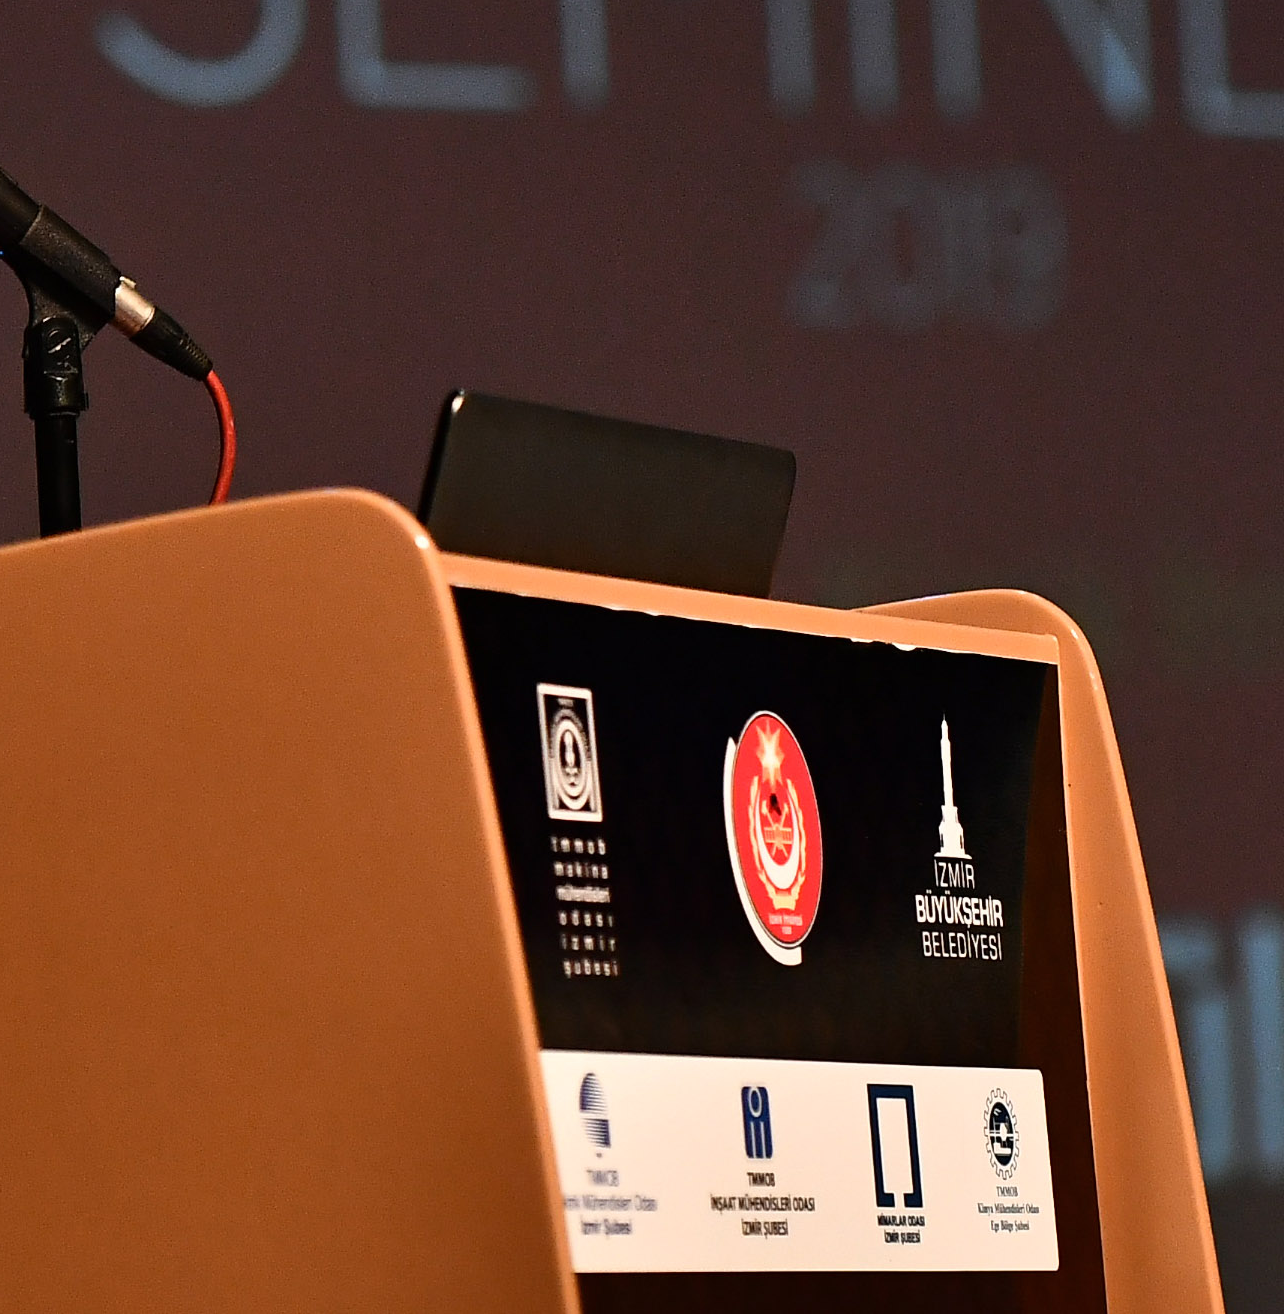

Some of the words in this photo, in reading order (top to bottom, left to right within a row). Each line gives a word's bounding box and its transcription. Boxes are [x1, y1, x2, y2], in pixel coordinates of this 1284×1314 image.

[786, 160, 1070, 330] 2019
[934, 859, 975, 889] İZMİR
[915, 889, 1004, 928] BÜYÜKŞEHİR
[922, 930, 1003, 960] BELEDİYESİ
[747, 1172, 776, 1187] TMMOB
[710, 1193, 736, 1214] İNŞAAT
[738, 1193, 792, 1212] MÜHENDİSLERİ
[793, 1196, 816, 1211] ODASI
[741, 1218, 763, 1236] İZMİR
[763, 1218, 789, 1239] ŞUBESİ
